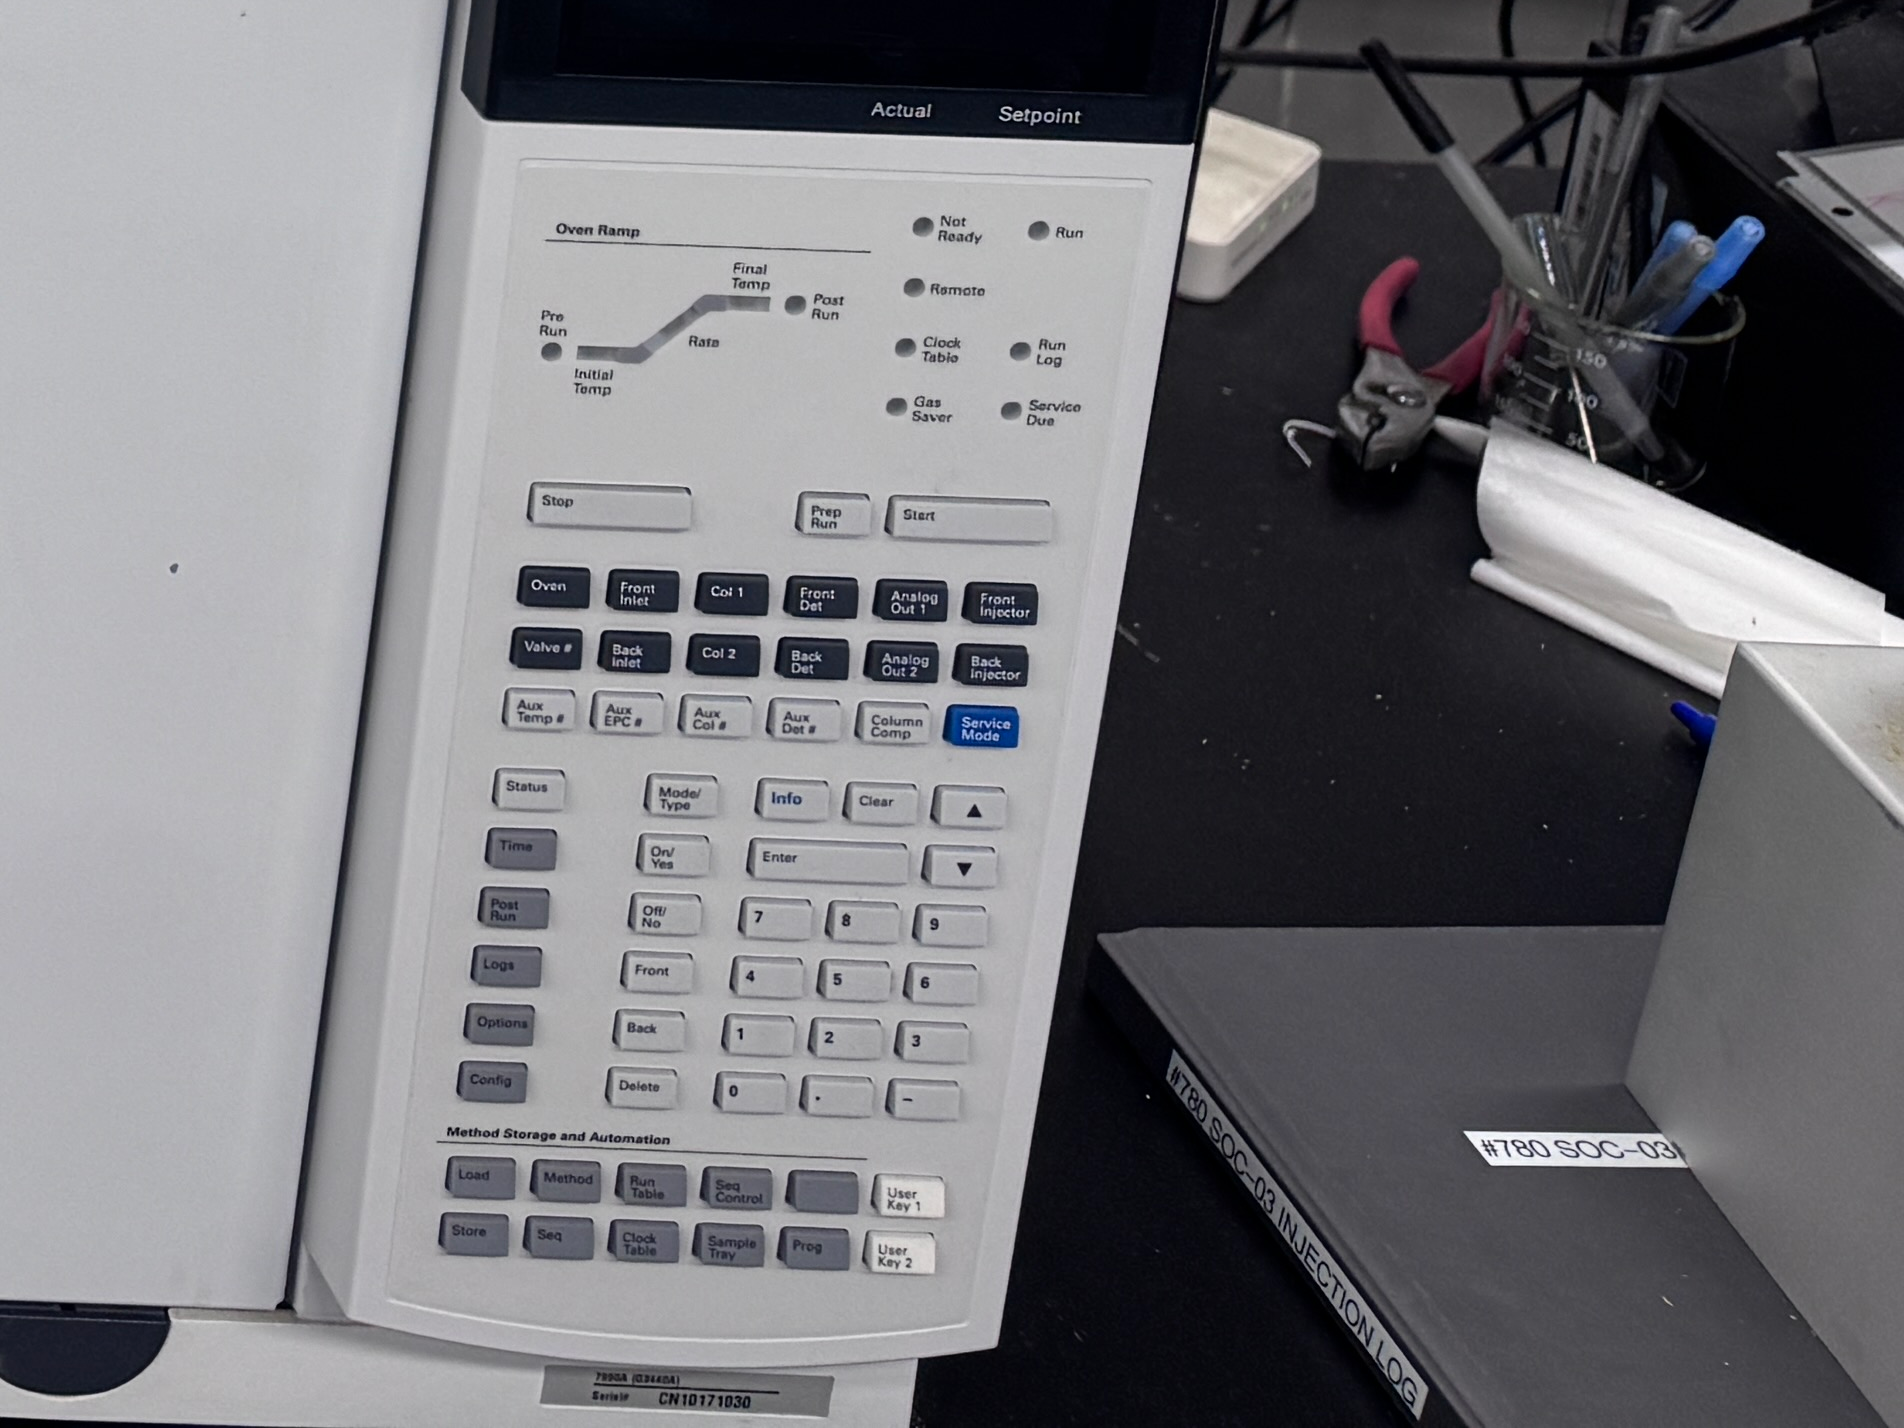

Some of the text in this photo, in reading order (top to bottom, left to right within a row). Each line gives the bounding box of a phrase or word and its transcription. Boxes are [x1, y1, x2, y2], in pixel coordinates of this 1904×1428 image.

[870, 101, 1081, 127] Actual Setpoint
[940, 214, 967, 228] Not
[555, 222, 641, 240] Oven Ramp
[937, 229, 983, 245] Ready
[1055, 226, 1084, 239] Run
[732, 261, 768, 275] Final
[731, 276, 771, 292] Temp
[929, 283, 986, 297] Remote
[813, 293, 845, 307] Post
[540, 309, 565, 323] Pre
[811, 307, 840, 321] Run
[539, 324, 568, 337] Run
[688, 334, 720, 348] Rate
[922, 335, 961, 349] Clock
[1038, 338, 1067, 351] Run
[922, 350, 959, 364] Table
[1036, 353, 1063, 369] Log
[574, 368, 614, 381] Initial
[573, 381, 612, 398] Temp
[913, 395, 942, 409] Gas
[1028, 399, 1082, 413] Service
[911, 410, 953, 423] Saver
[1026, 413, 1055, 427] Due
[541, 494, 574, 509] Stop
[810, 504, 842, 526] Prep
[903, 508, 936, 522] Start
[810, 516, 838, 529] Run
[530, 578, 567, 592] Oven
[620, 581, 655, 595] Front
[710, 585, 733, 598] Col
[619, 593, 649, 607] Inlet
[800, 586, 835, 600] Front
[890, 590, 939, 606] Analog
[980, 592, 1016, 606] Front
[799, 598, 823, 612] Det
[890, 602, 916, 615] Out
[980, 605, 1031, 620] Injector
[524, 640, 561, 654] Valve
[612, 643, 643, 656] Back
[701, 646, 725, 659] Col
[611, 656, 641, 669] Inlet
[791, 649, 822, 662] Back
[880, 652, 930, 669] Analog
[971, 655, 1002, 668] Back
[791, 662, 814, 675] Det
[881, 664, 906, 678] Out
[970, 668, 1021, 682] Injector
[516, 699, 544, 711] Aux
[517, 710, 553, 726] Temp
[869, 713, 925, 729] Column
[961, 716, 1012, 730] Service
[869, 726, 914, 743] Comp
[961, 728, 1000, 742] Mode
[505, 779, 548, 793] Status
[658, 786, 702, 799] Mode/
[660, 798, 691, 812] Type
[771, 791, 803, 806] Info
[858, 794, 895, 808] Clear
[499, 839, 534, 853] Time
[650, 845, 675, 858] On/
[651, 858, 674, 870] Yes
[762, 850, 798, 864] Enter
[642, 904, 667, 917] Off/
[641, 917, 662, 929] No
[483, 958, 515, 973] Logs
[634, 963, 670, 977] Front
[476, 1015, 529, 1030] Options
[626, 1021, 657, 1034] Back
[469, 1073, 512, 1089] Config
[618, 1079, 661, 1093] Delete
[446, 1126, 671, 1146] Method Storage and Automation
[1479, 1138, 1679, 1160] #780 SOC-03
[458, 1168, 491, 1182] Load
[543, 1171, 594, 1185] Method
[629, 1174, 656, 1188] Run
[887, 1187, 918, 1200] User
[887, 1199, 911, 1212] Key
[1169, 1065, 1419, 1410] #780 SOC-03 INJECTION LOG
[877, 1243, 908, 1257] User
[877, 1256, 901, 1270] Key
